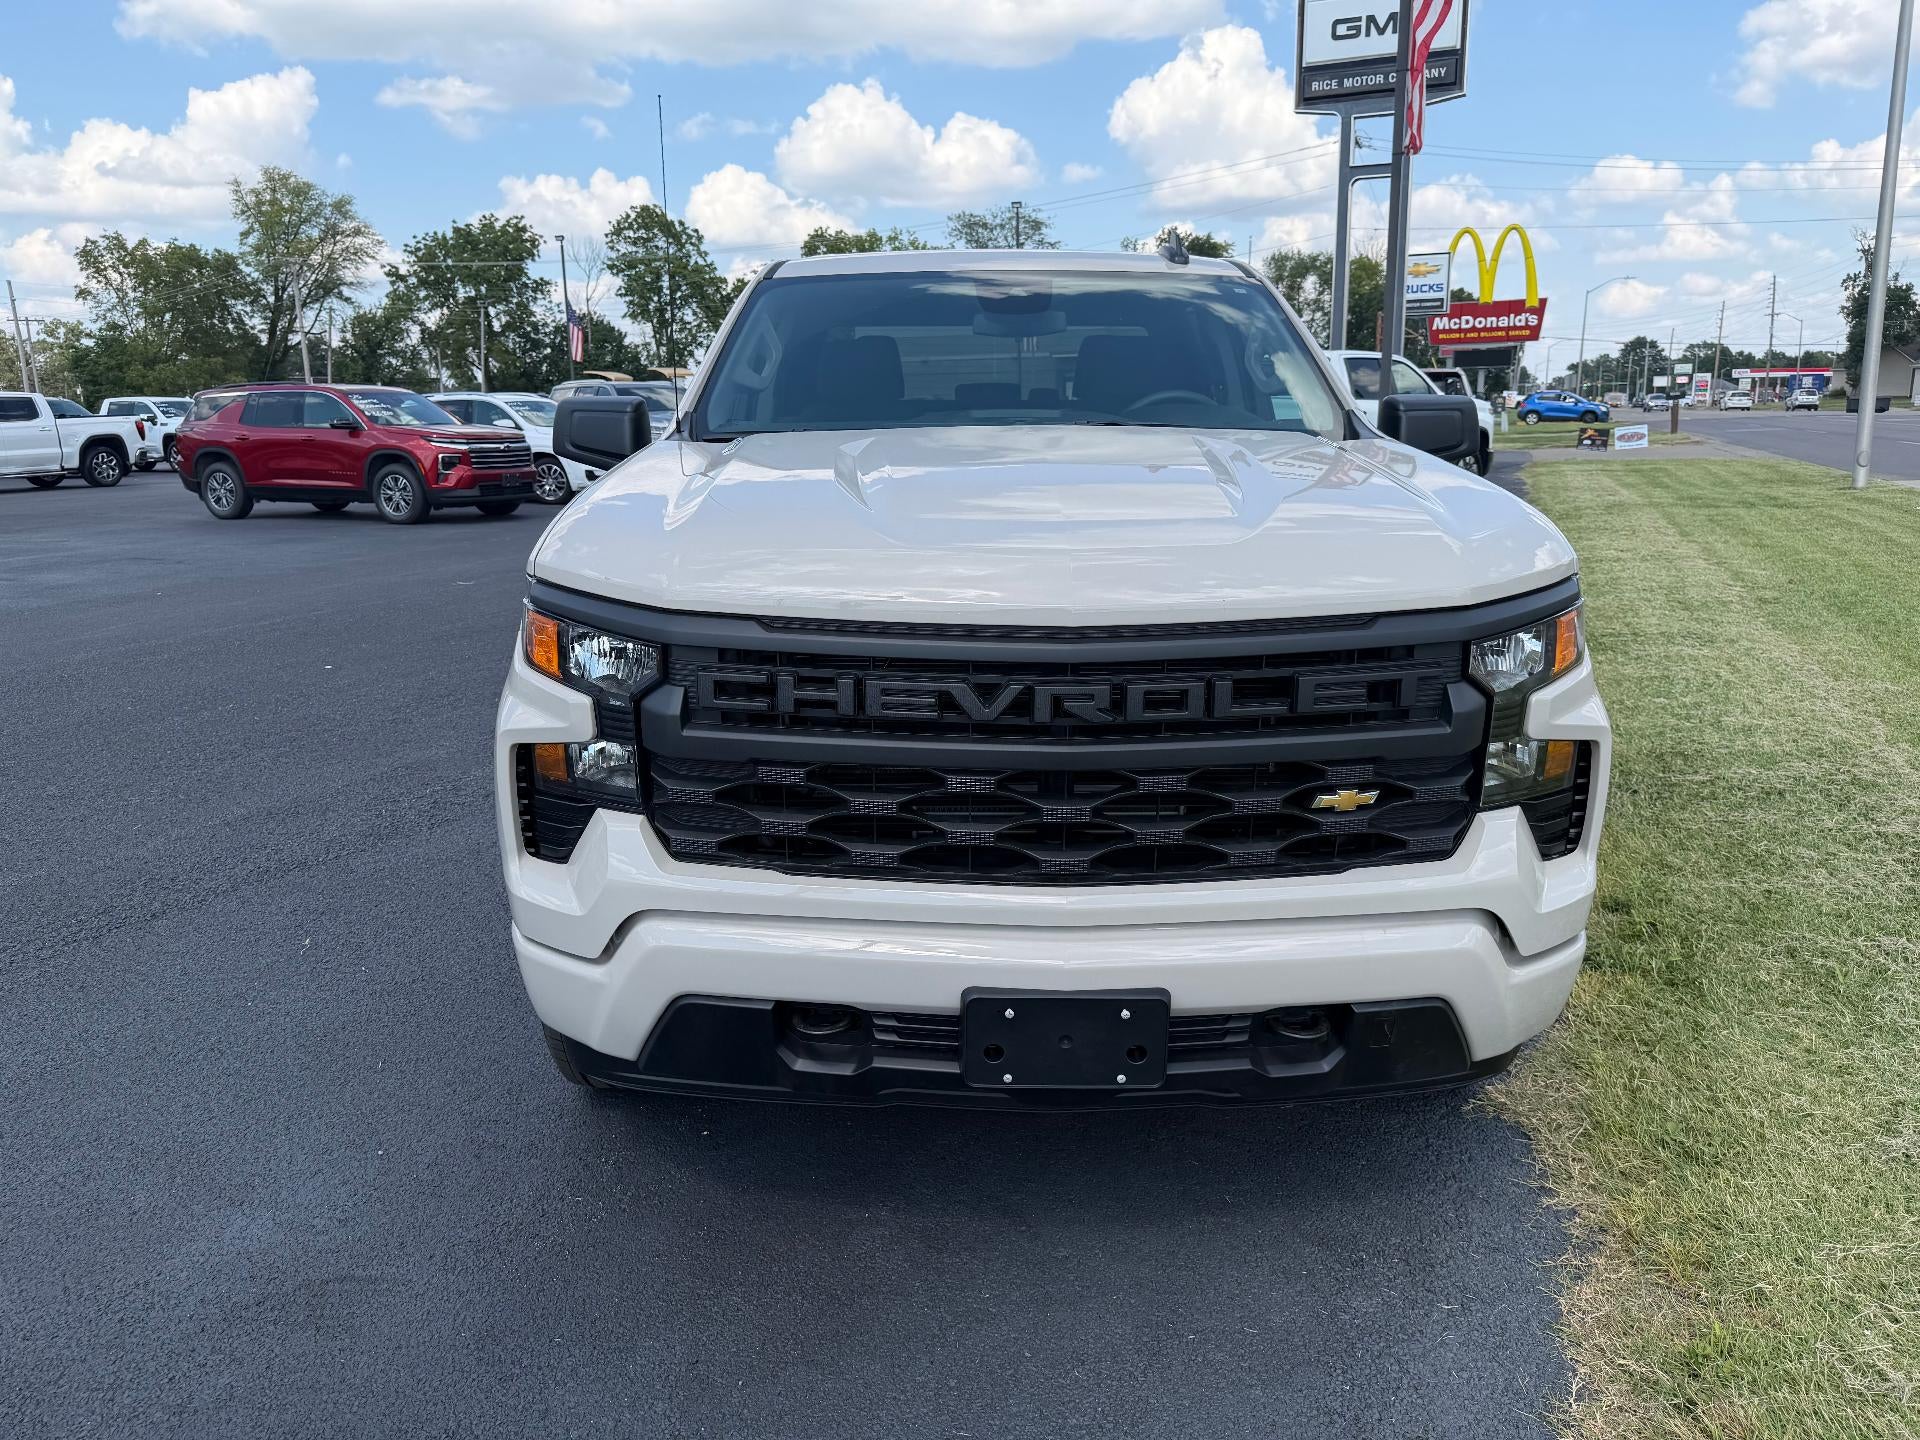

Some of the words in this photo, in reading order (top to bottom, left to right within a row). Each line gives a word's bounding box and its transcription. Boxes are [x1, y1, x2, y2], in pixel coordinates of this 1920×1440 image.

[1331, 12, 1398, 41] GM
[1311, 79, 1339, 92] RICE
[1343, 73, 1384, 88] MOTOR
[1389, 67, 1447, 83] CANY
[1406, 282, 1444, 294] UCKS
[1432, 313, 1538, 331] McDonald's
[697, 664, 1442, 723] CHEVROLET
